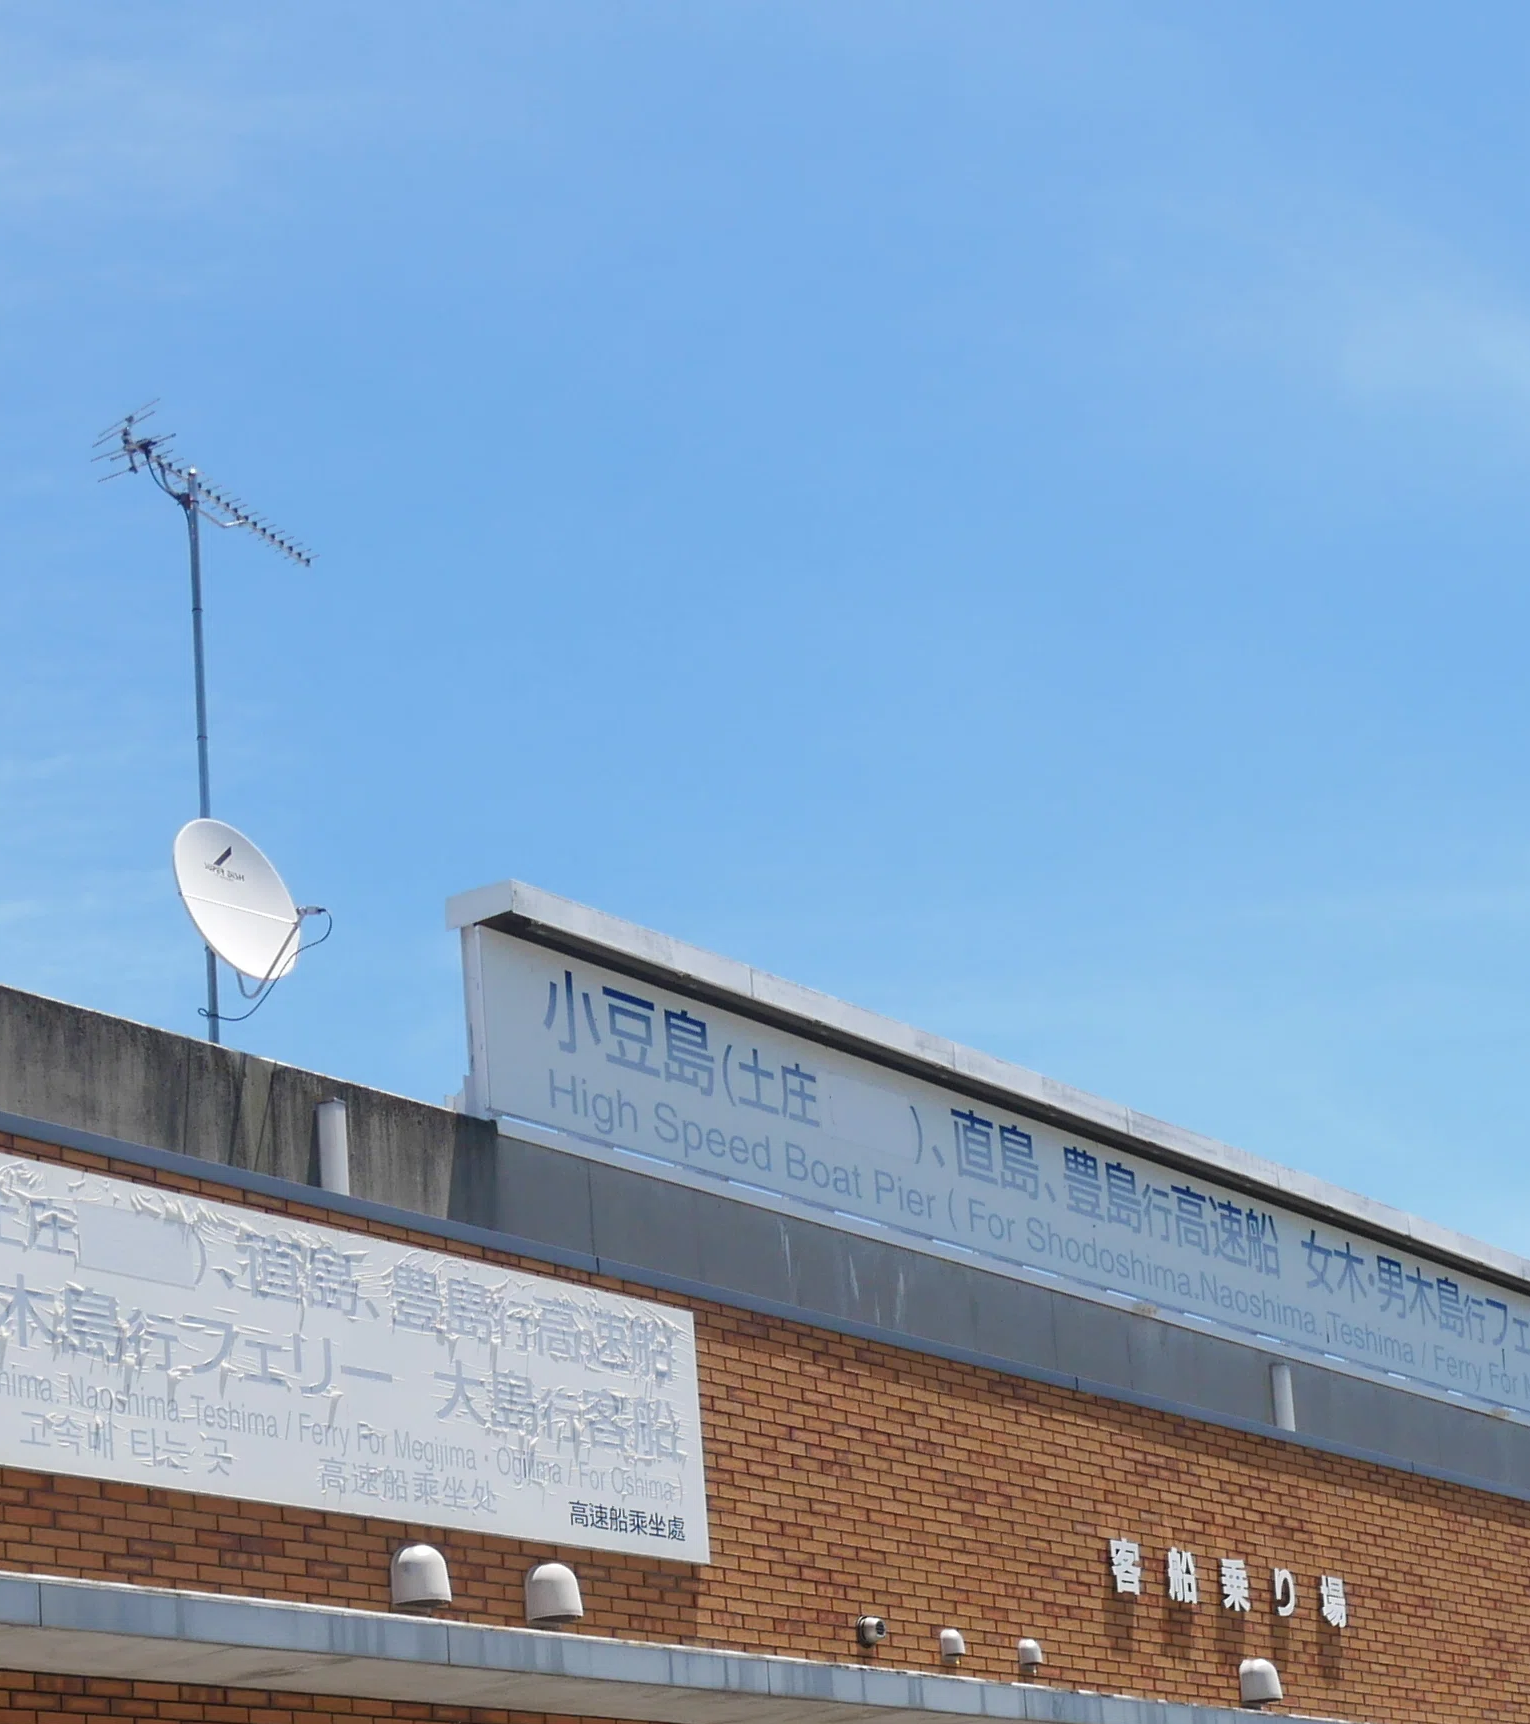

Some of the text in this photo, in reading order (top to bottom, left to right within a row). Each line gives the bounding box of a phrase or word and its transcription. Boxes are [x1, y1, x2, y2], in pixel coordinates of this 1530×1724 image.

[549, 1068, 639, 1135] High
[654, 1102, 772, 1173] Speed
[785, 1141, 863, 1200] Boat
[874, 1169, 947, 1221] Pier
[969, 1197, 1016, 1242] For
[1433, 1345, 1483, 1392] Ferry
[191, 1394, 278, 1440] Teshima
[299, 1411, 349, 1457] Ferry
[578, 1460, 606, 1492] For
[1109, 1537, 1348, 1629] 客船乗り場
